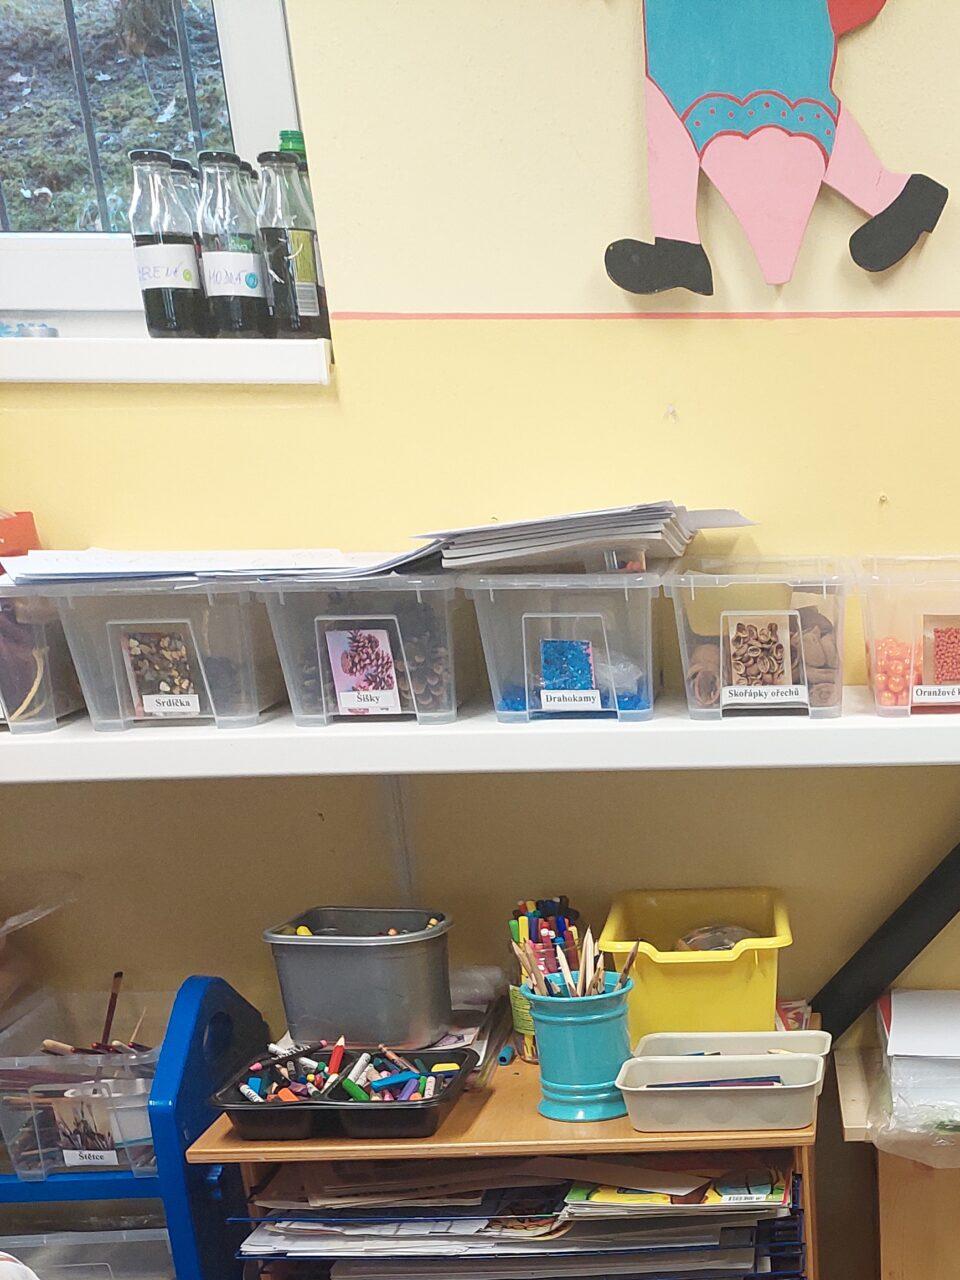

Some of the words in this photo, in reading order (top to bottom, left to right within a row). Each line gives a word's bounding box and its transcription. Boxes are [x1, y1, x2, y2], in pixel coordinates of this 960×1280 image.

[356, 690, 381, 704] Šišky
[727, 687, 769, 701] Skořápky
[770, 687, 800, 698] ořechů
[915, 687, 956, 698] Oranžové
[545, 693, 597, 704] Drahokamy
[78, 1151, 105, 1161] Štětce
